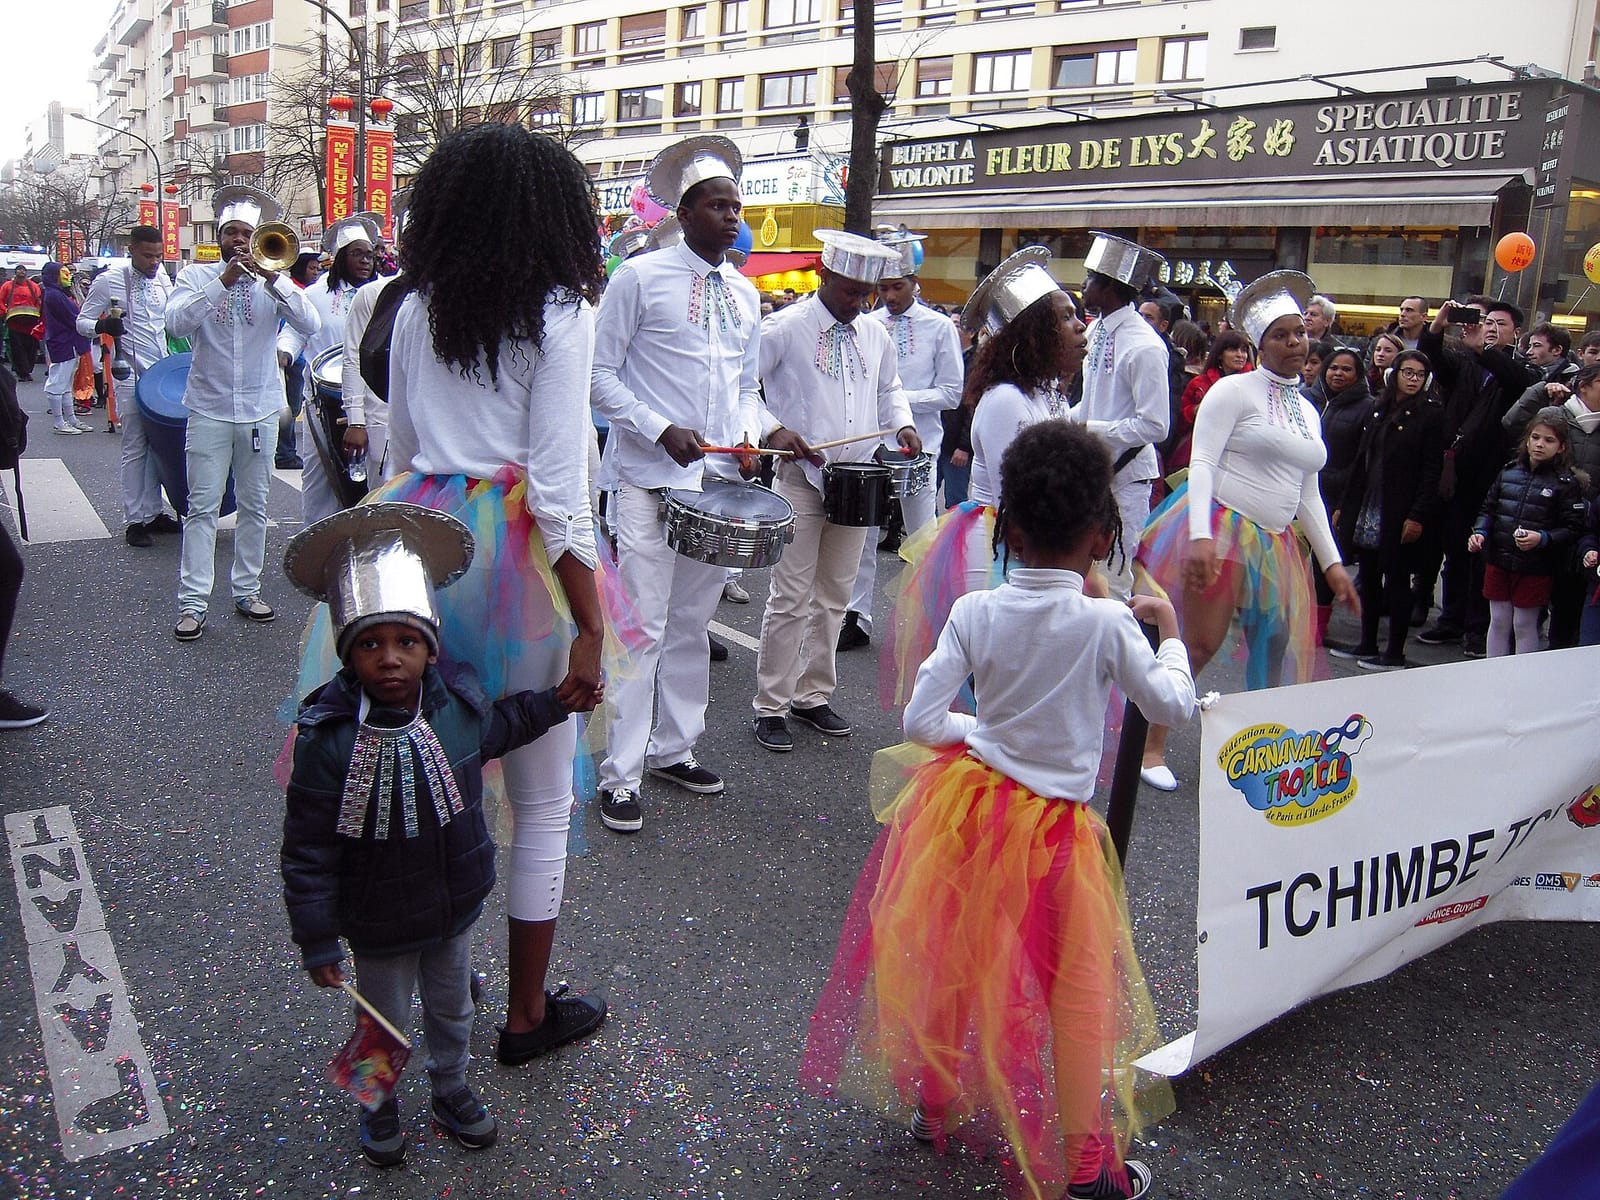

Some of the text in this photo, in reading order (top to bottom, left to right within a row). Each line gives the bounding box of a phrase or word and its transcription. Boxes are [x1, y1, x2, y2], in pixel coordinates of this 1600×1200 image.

[1315, 91, 1522, 133] SPECIALITE
[891, 139, 975, 166] BUFFET A
[985, 132, 1184, 176] FLEUR DE LYS
[1187, 115, 1296, 162] 大家好
[1313, 130, 1507, 168] ASIATIQUE
[371, 145, 388, 181] BONNE
[890, 164, 975, 188] VOLONTE
[1218, 726, 1281, 764] Fédération du
[1228, 733, 1322, 780] CARNAVAL
[1265, 754, 1348, 804] TROPICAL
[1266, 810, 1275, 820] de
[1276, 809, 1294, 821] Paris
[1246, 828, 1495, 950] TCHIMBE
